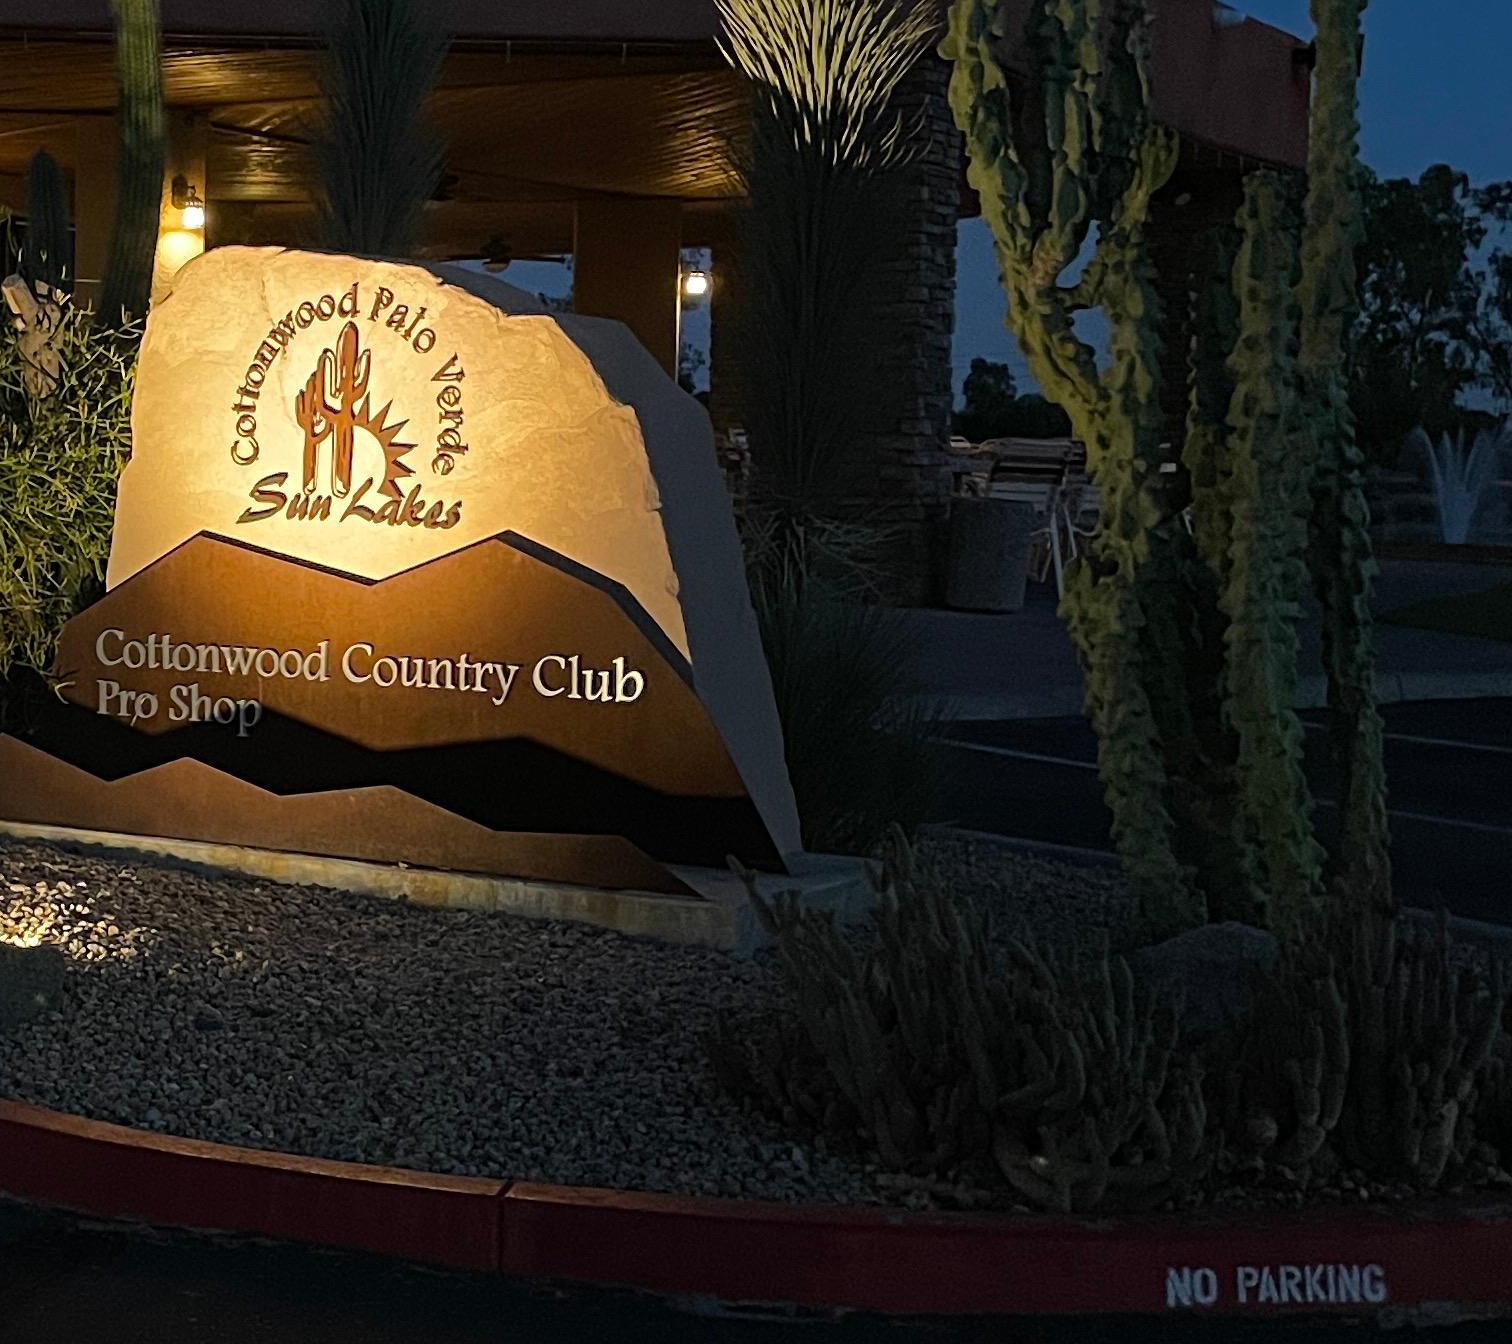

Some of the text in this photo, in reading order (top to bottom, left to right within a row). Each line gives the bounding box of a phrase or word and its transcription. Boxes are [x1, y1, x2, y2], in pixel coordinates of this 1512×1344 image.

[231, 282, 469, 476] Cottonwood Palo Verde
[235, 472, 463, 529] Sun Lakes
[95, 628, 645, 706] Cottonwood Country Club
[96, 679, 263, 737] Pro Shop
[1165, 1263, 1387, 1307] NO PARKING
